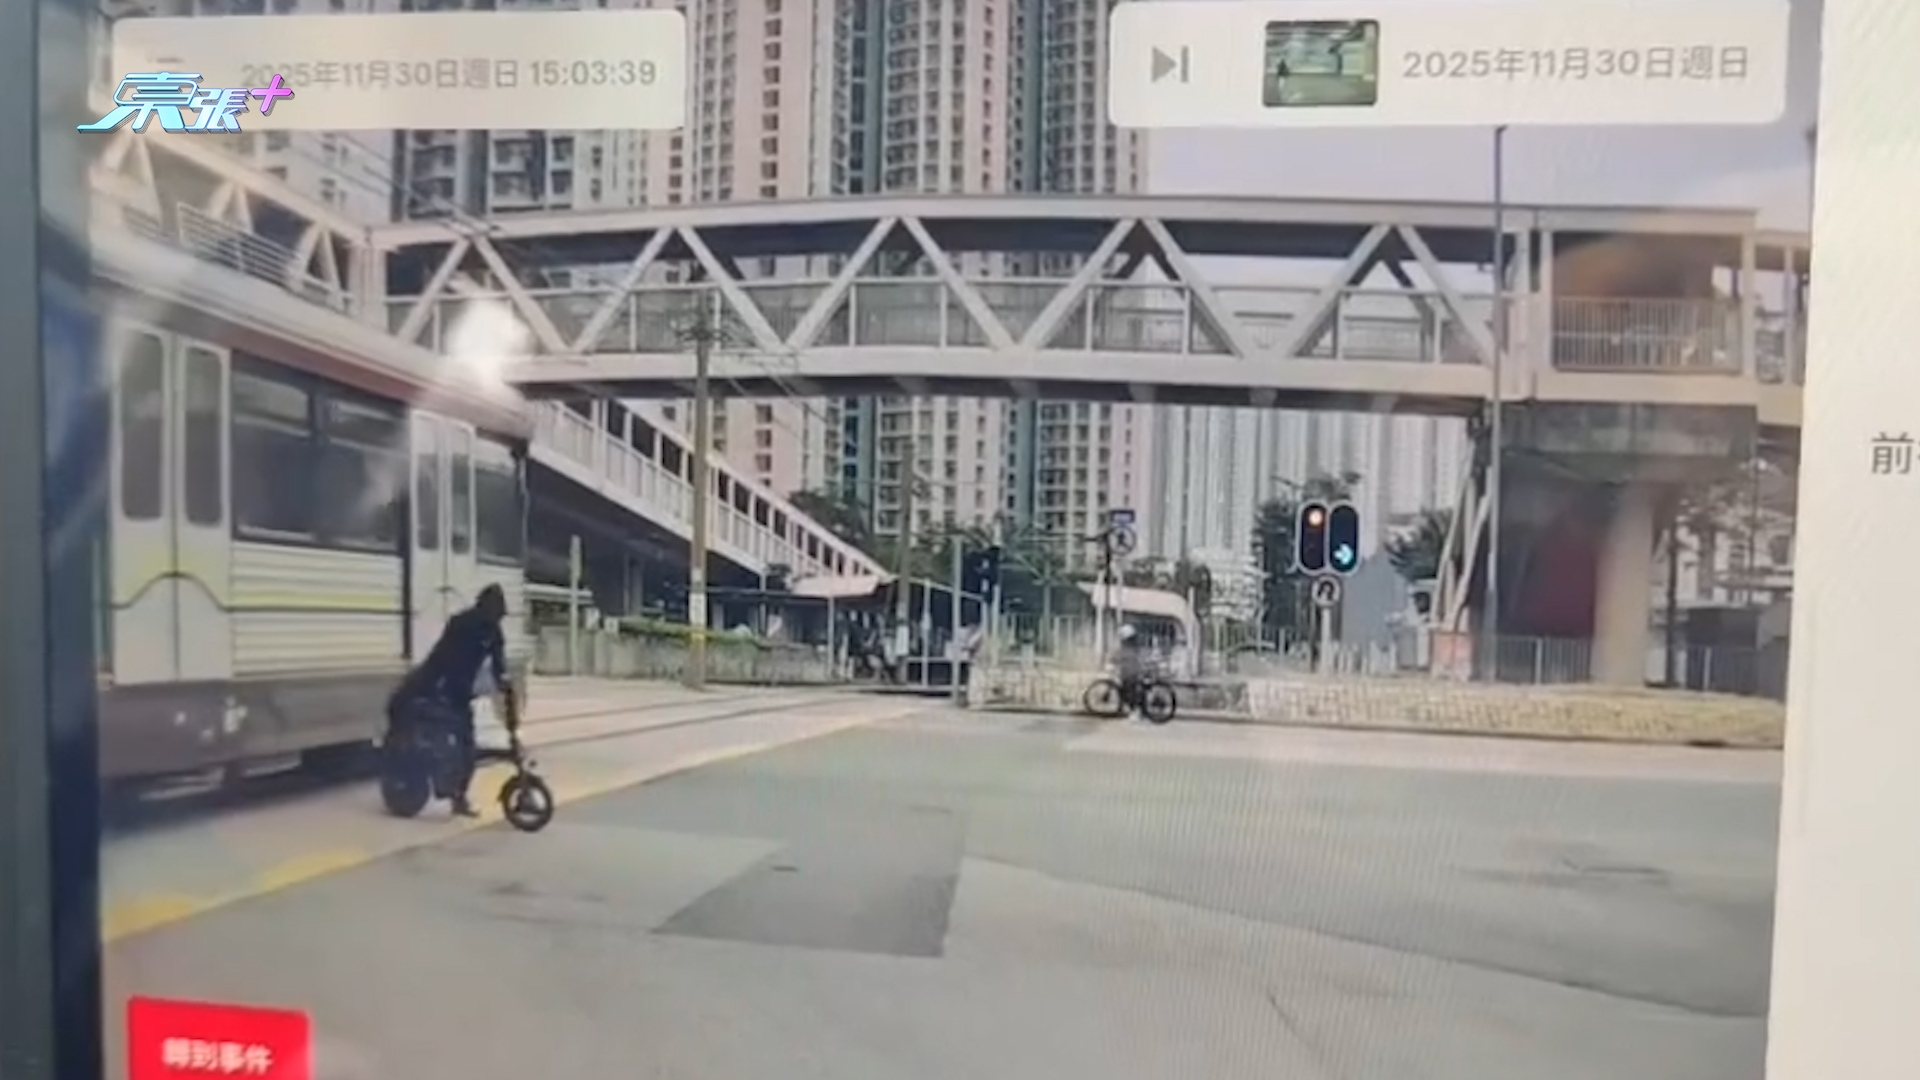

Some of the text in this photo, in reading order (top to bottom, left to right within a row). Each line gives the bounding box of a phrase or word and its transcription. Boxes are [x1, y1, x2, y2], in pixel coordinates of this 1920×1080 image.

[241, 57, 657, 91] 2025年11月30日週日 15:03:39
[1402, 45, 1749, 81] 2025年11月30日週日
[1871, 431, 1920, 475] 前
